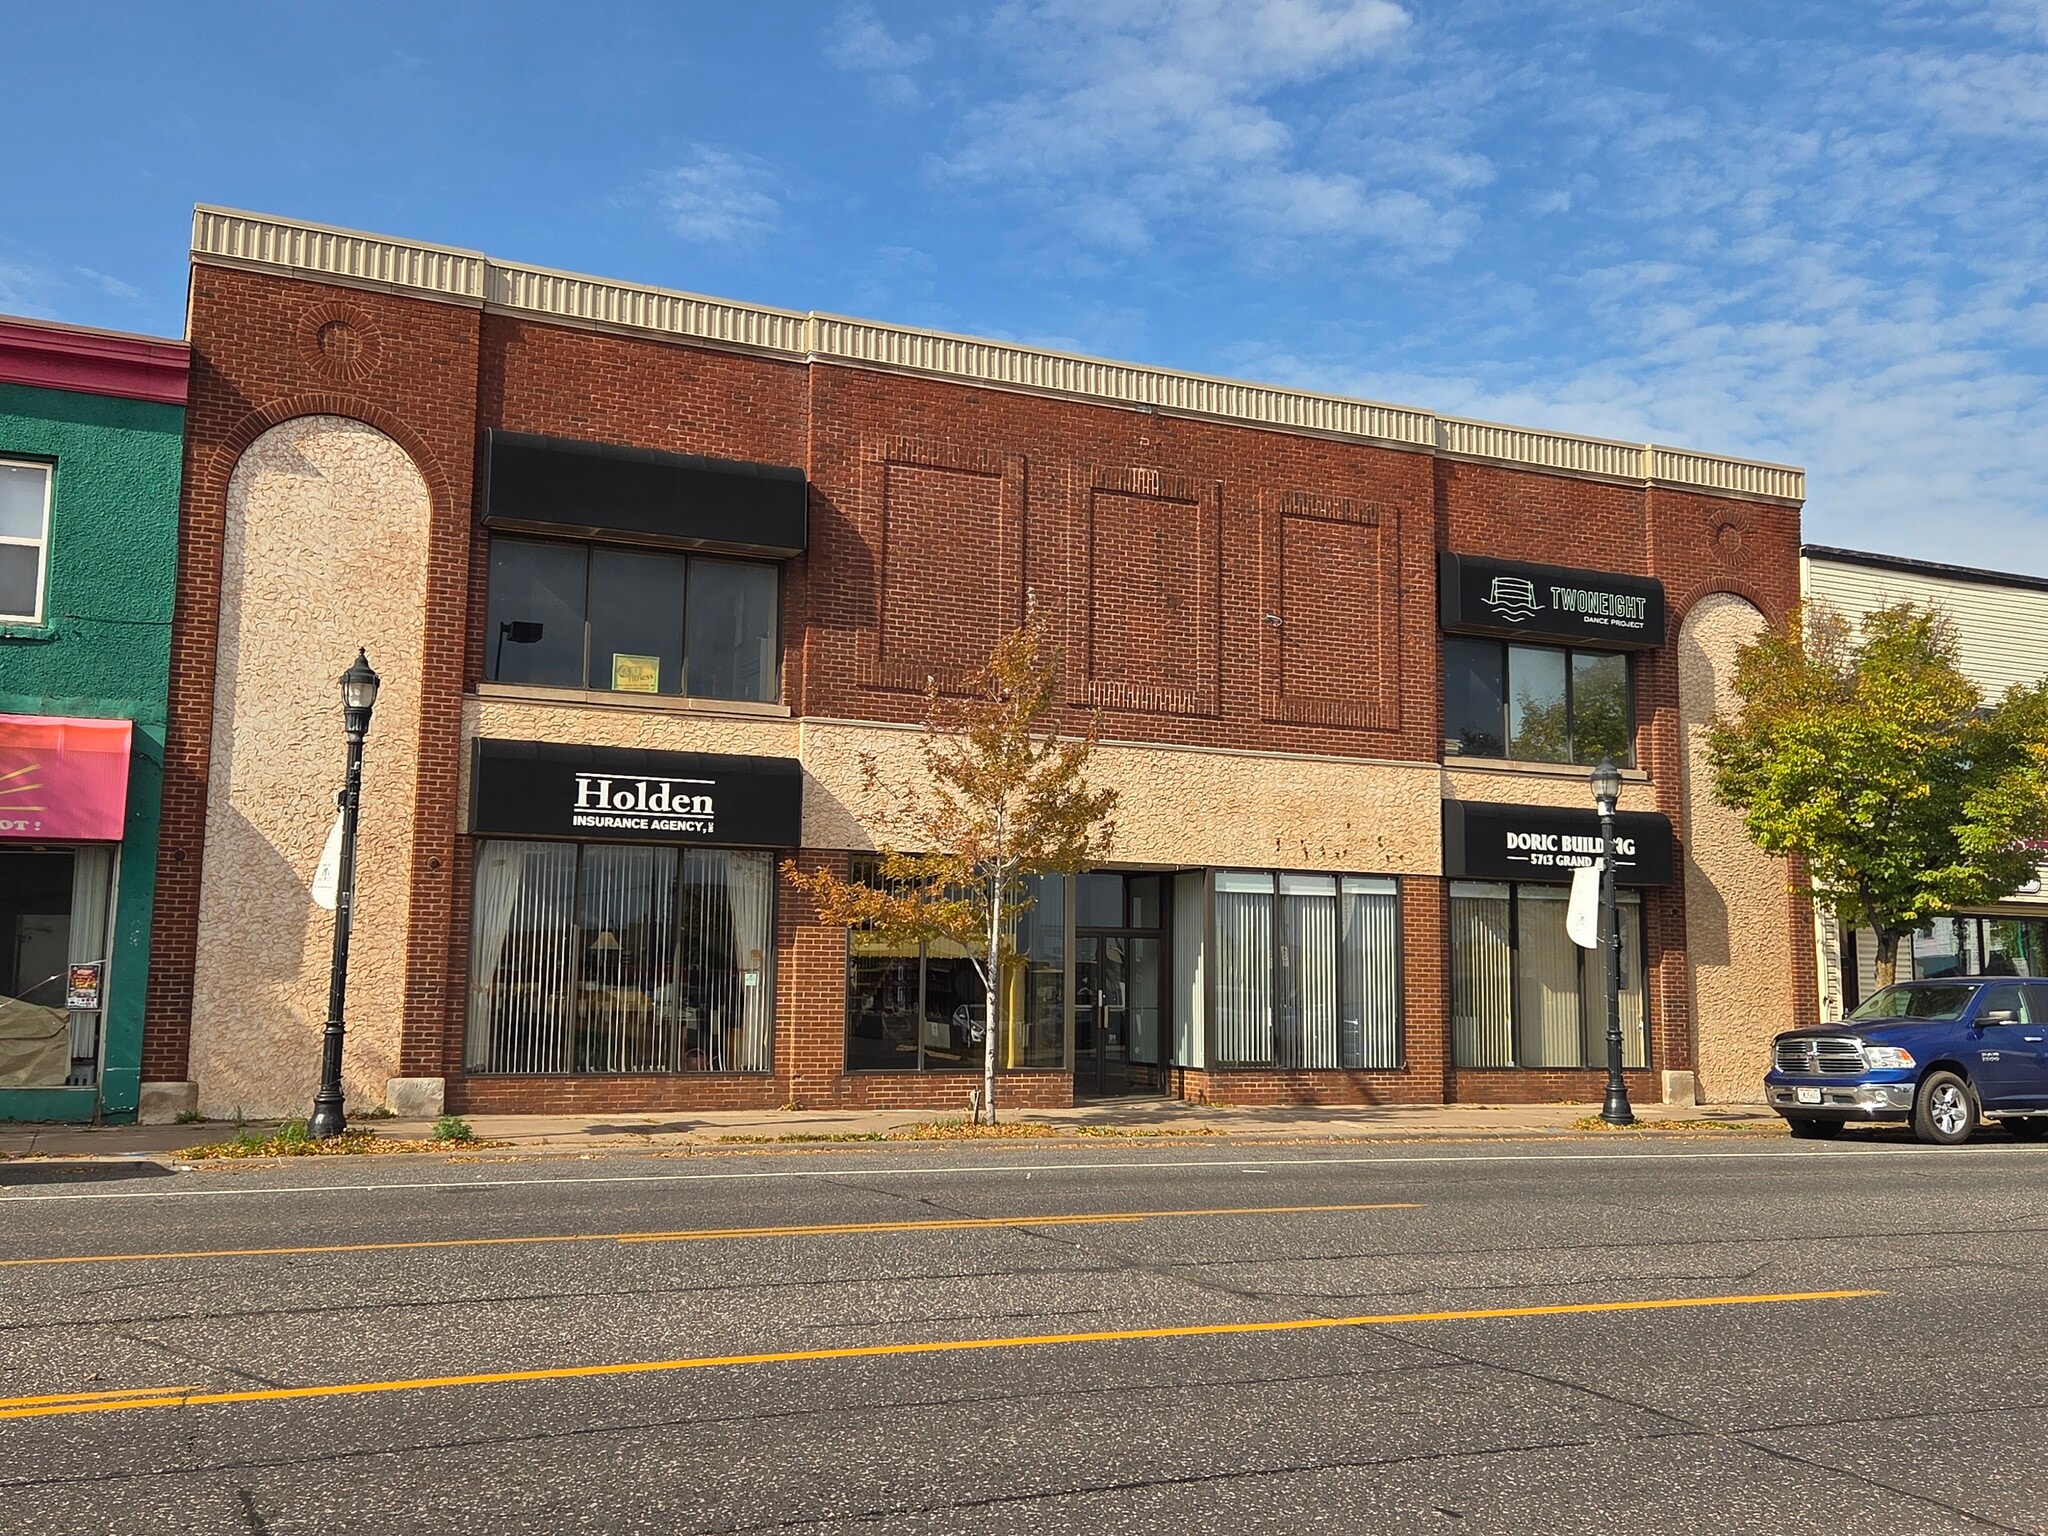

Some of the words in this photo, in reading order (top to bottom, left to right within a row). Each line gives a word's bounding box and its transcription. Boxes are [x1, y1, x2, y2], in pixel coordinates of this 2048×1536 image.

[1550, 586, 1646, 620] TWONEIGHT
[1583, 615, 1610, 625] DANCE
[1610, 619, 1645, 629] PROJECT
[573, 778, 715, 814] Holden
[572, 815, 649, 830] INSURANCE
[650, 819, 707, 835] AGENCY,
[1506, 832, 1558, 852] DORIC
[1530, 853, 1554, 866] 5713
[1556, 854, 1593, 867] GRAND
